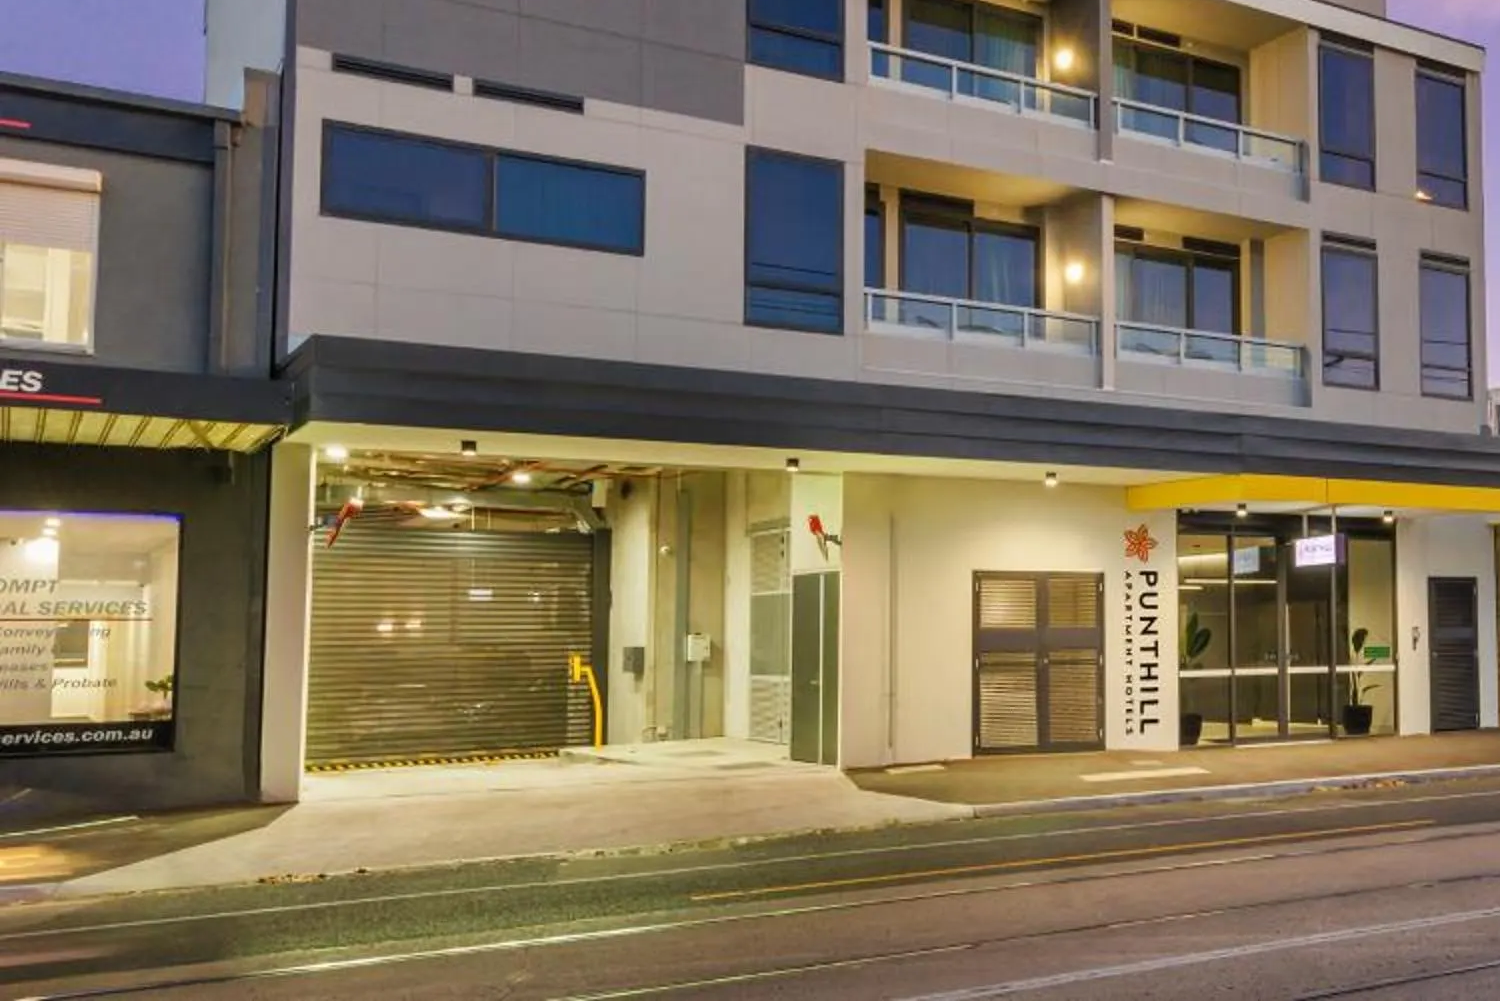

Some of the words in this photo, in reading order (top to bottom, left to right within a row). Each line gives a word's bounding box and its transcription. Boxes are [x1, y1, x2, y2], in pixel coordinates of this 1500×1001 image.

[37, 600, 148, 616] SERVICES
[1124, 570, 1134, 666] APARTMENT
[1139, 570, 1160, 735] PUNTHILL
[52, 677, 118, 691] Probate
[1125, 674, 1135, 737] HOTELS
[1, 728, 153, 746] ervices.com.au
